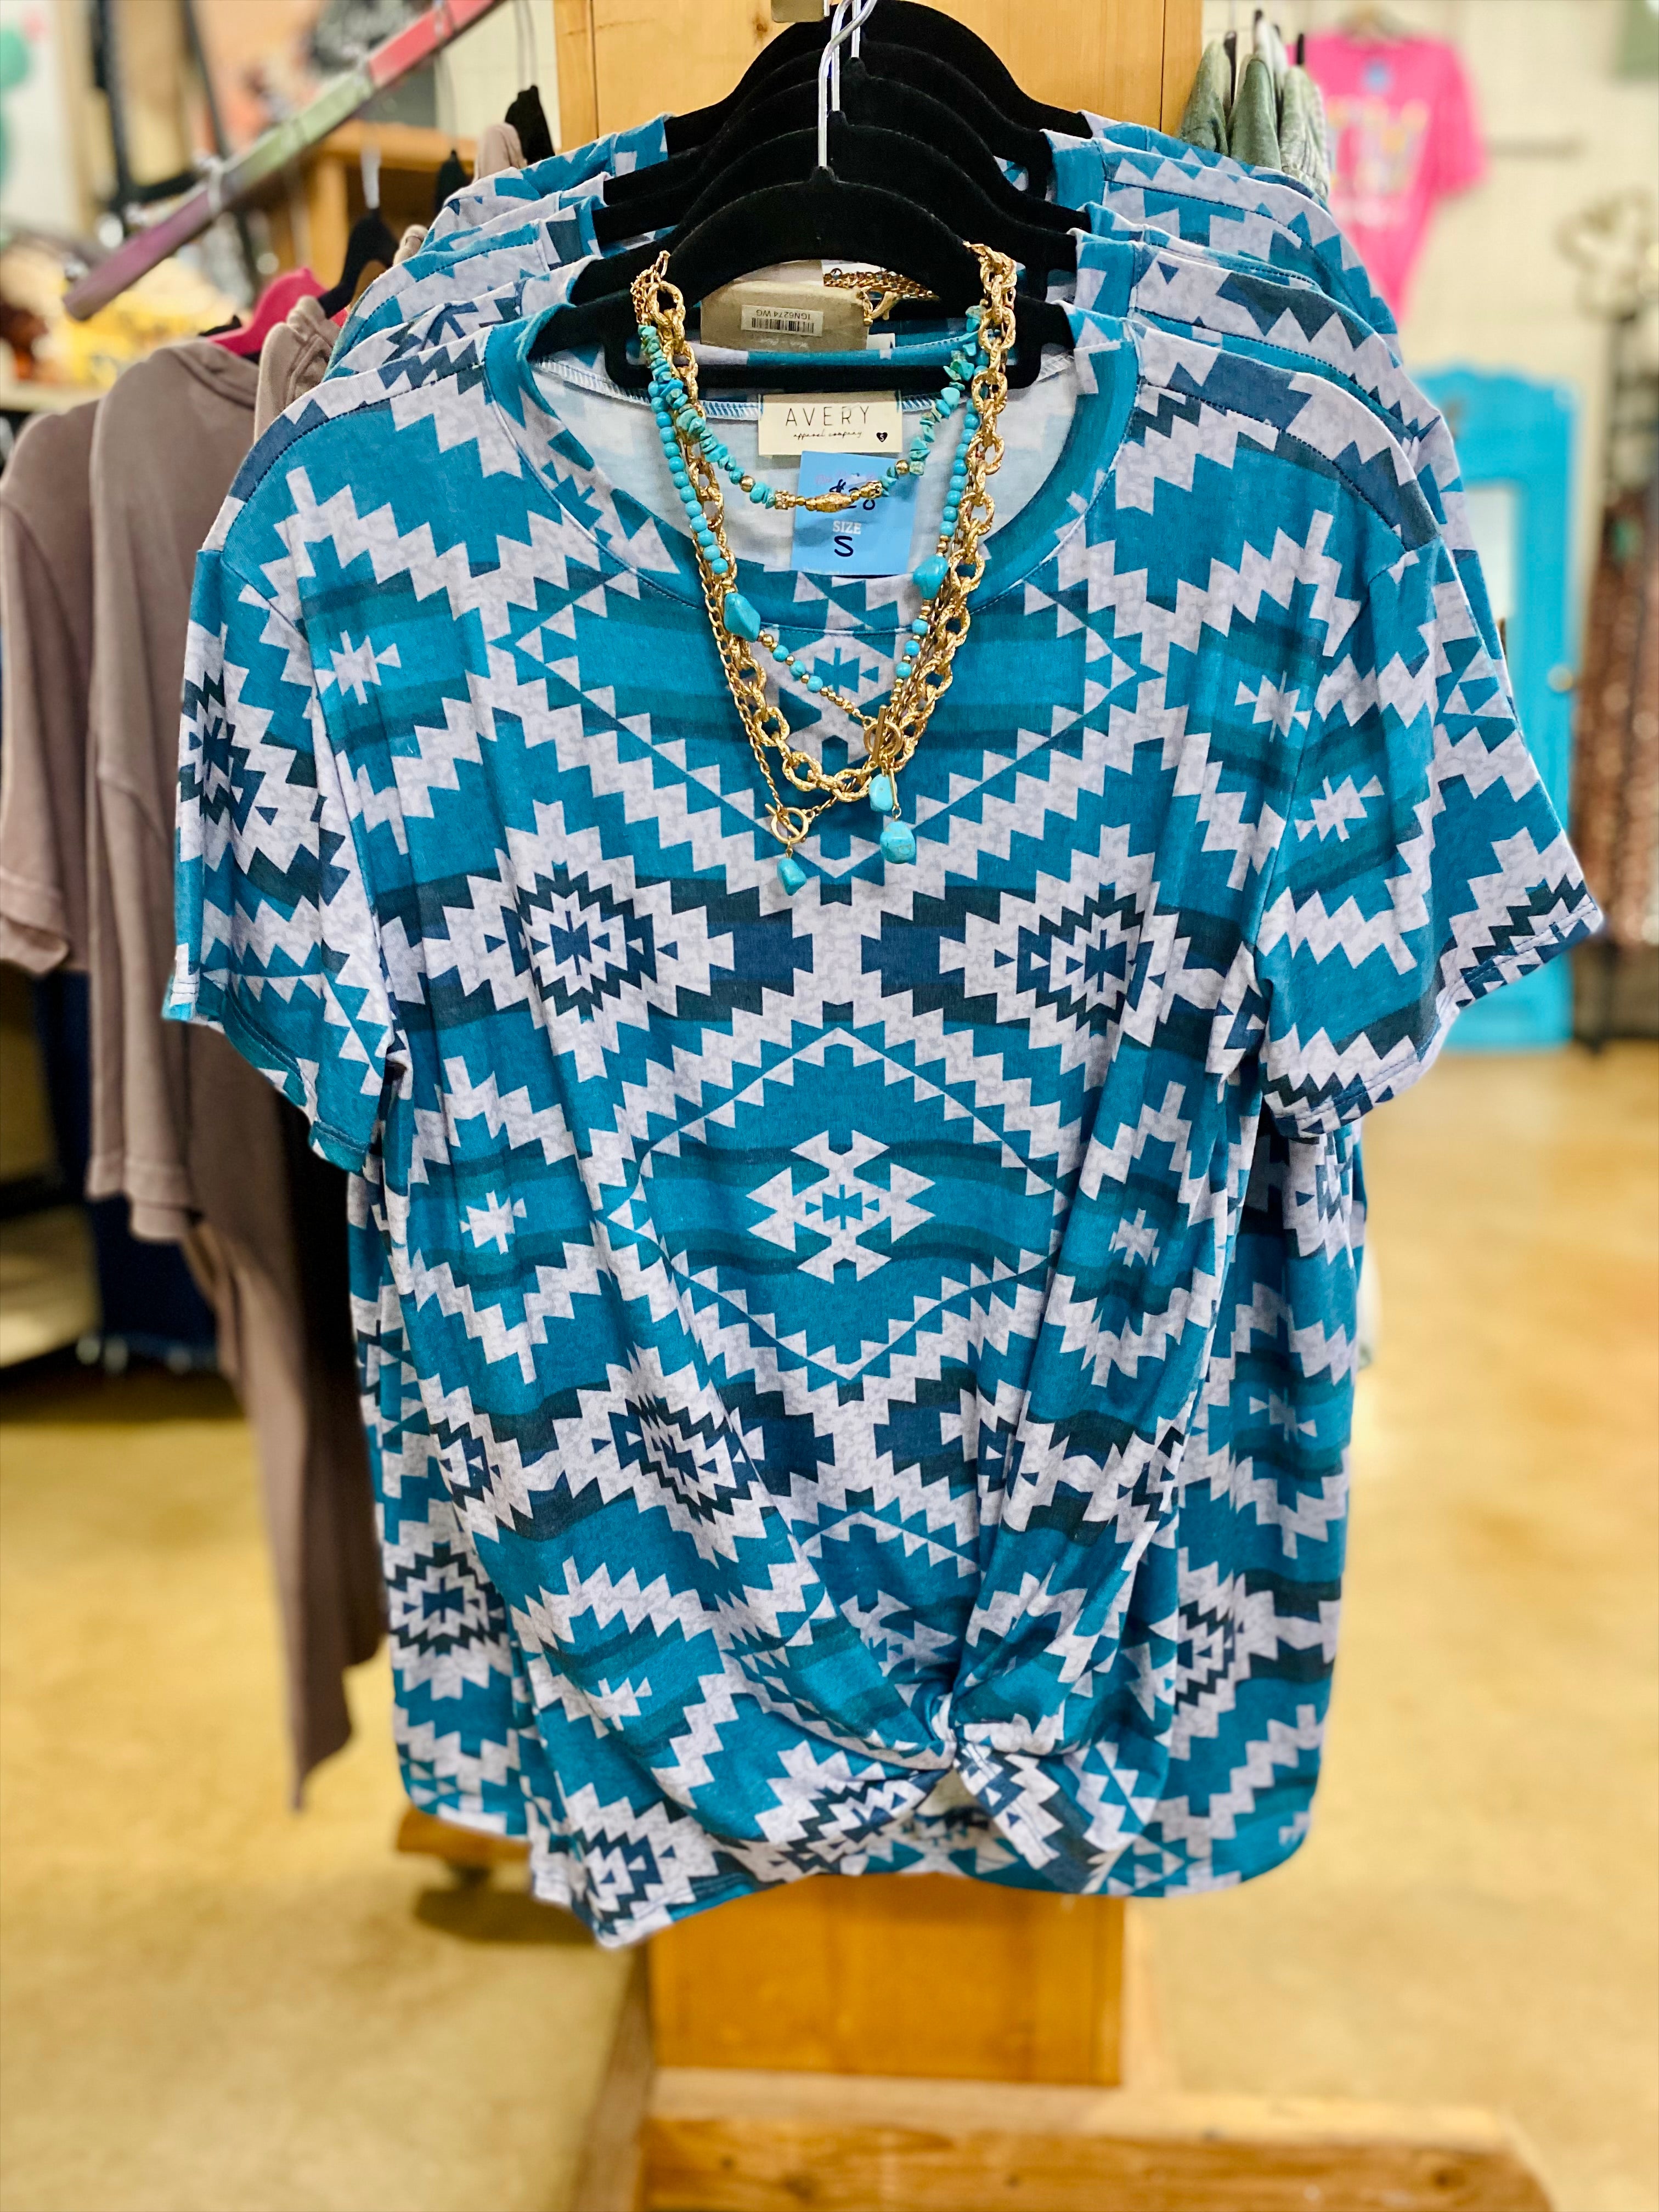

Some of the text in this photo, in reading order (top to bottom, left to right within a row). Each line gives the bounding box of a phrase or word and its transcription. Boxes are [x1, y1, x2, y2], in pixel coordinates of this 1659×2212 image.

[786, 406, 869, 426] AVERY
[833, 521, 861, 534] SIZE
[834, 535, 853, 557] S
